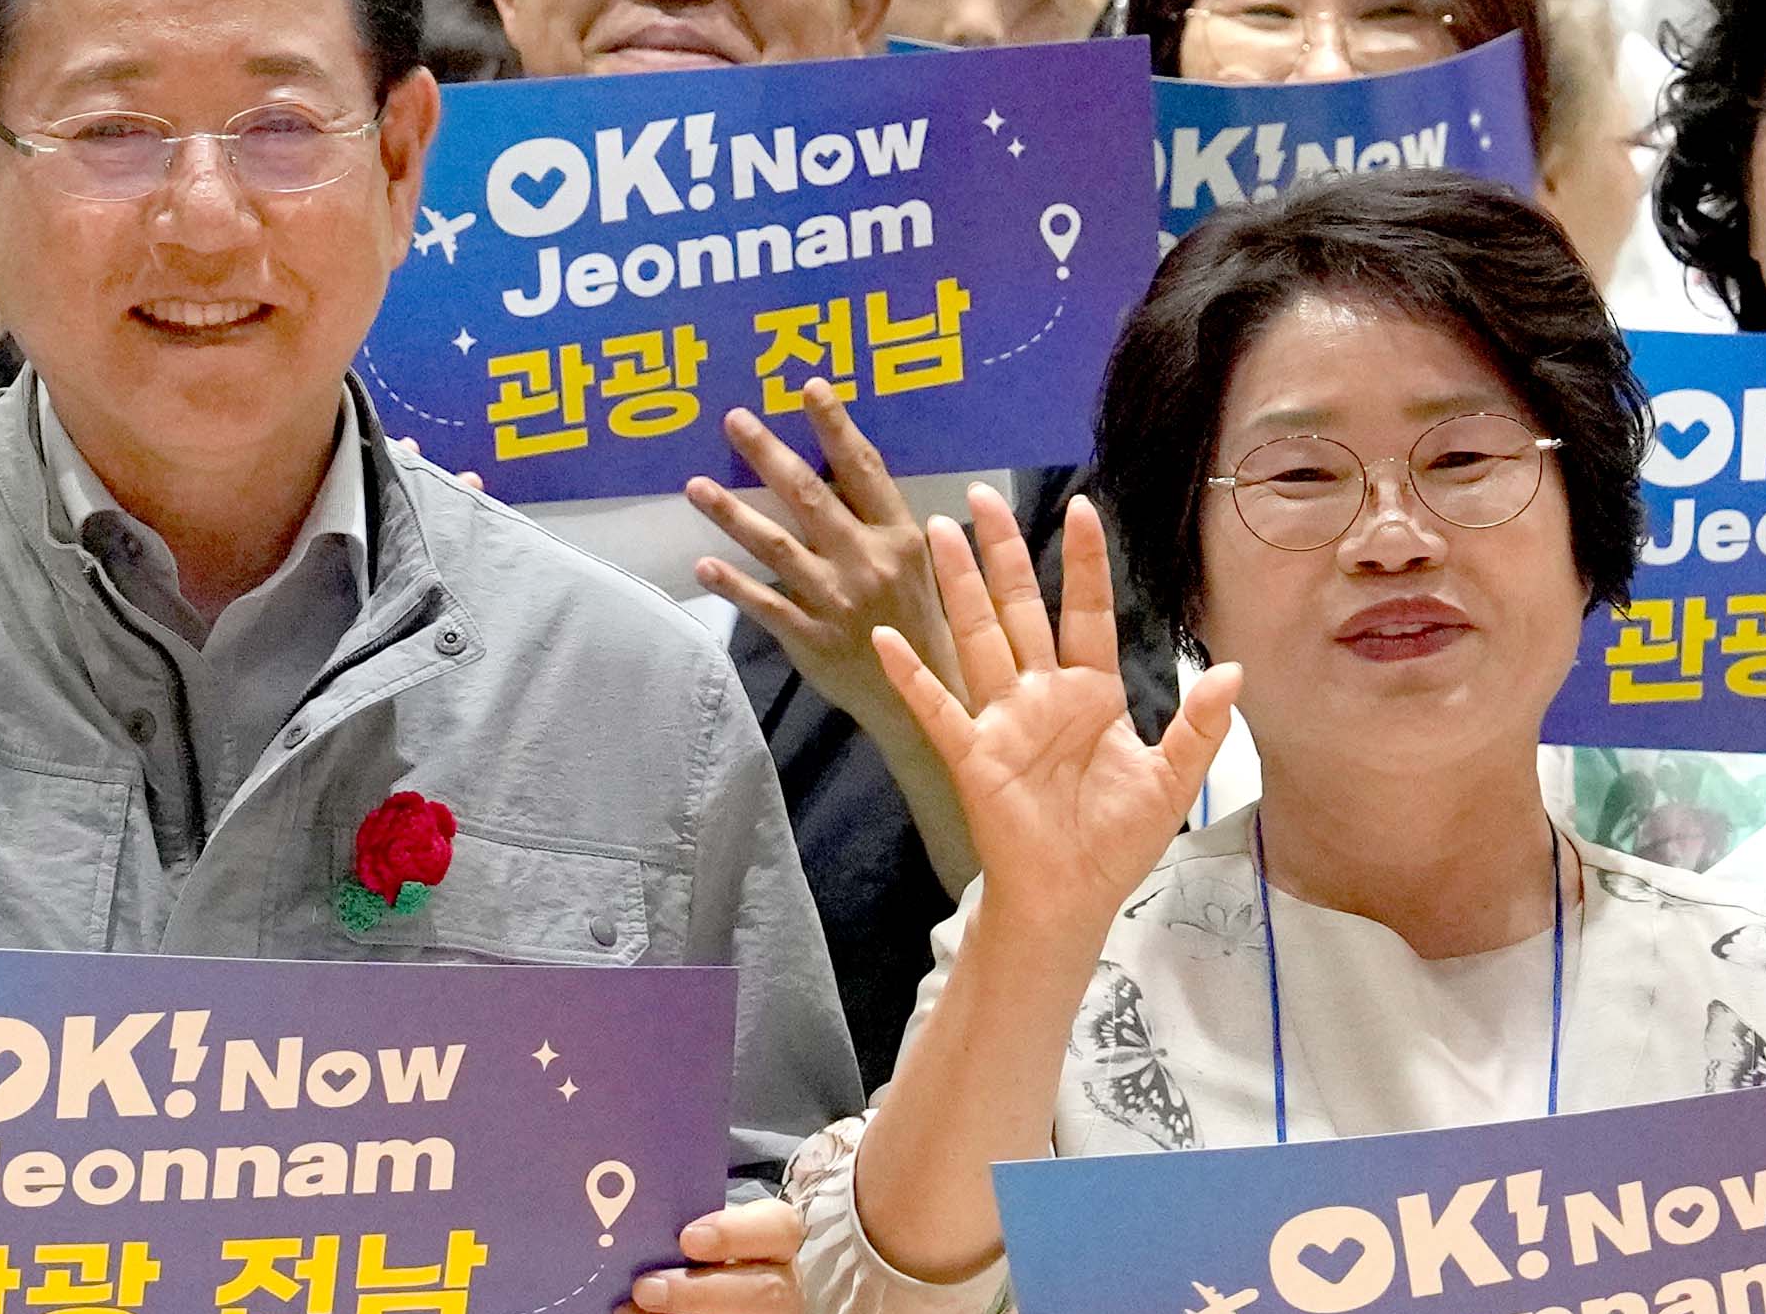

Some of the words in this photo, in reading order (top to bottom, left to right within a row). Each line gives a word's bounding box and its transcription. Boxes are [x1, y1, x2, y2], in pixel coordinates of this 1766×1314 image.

[485, 112, 718, 238] OK!
[731, 118, 930, 202] Now
[1153, 122, 1288, 209] K!
[501, 198, 934, 319] Jeonnam
[486, 319, 710, 462] 관광
[752, 276, 973, 417] 전남
[218, 1033, 469, 1114] Now
